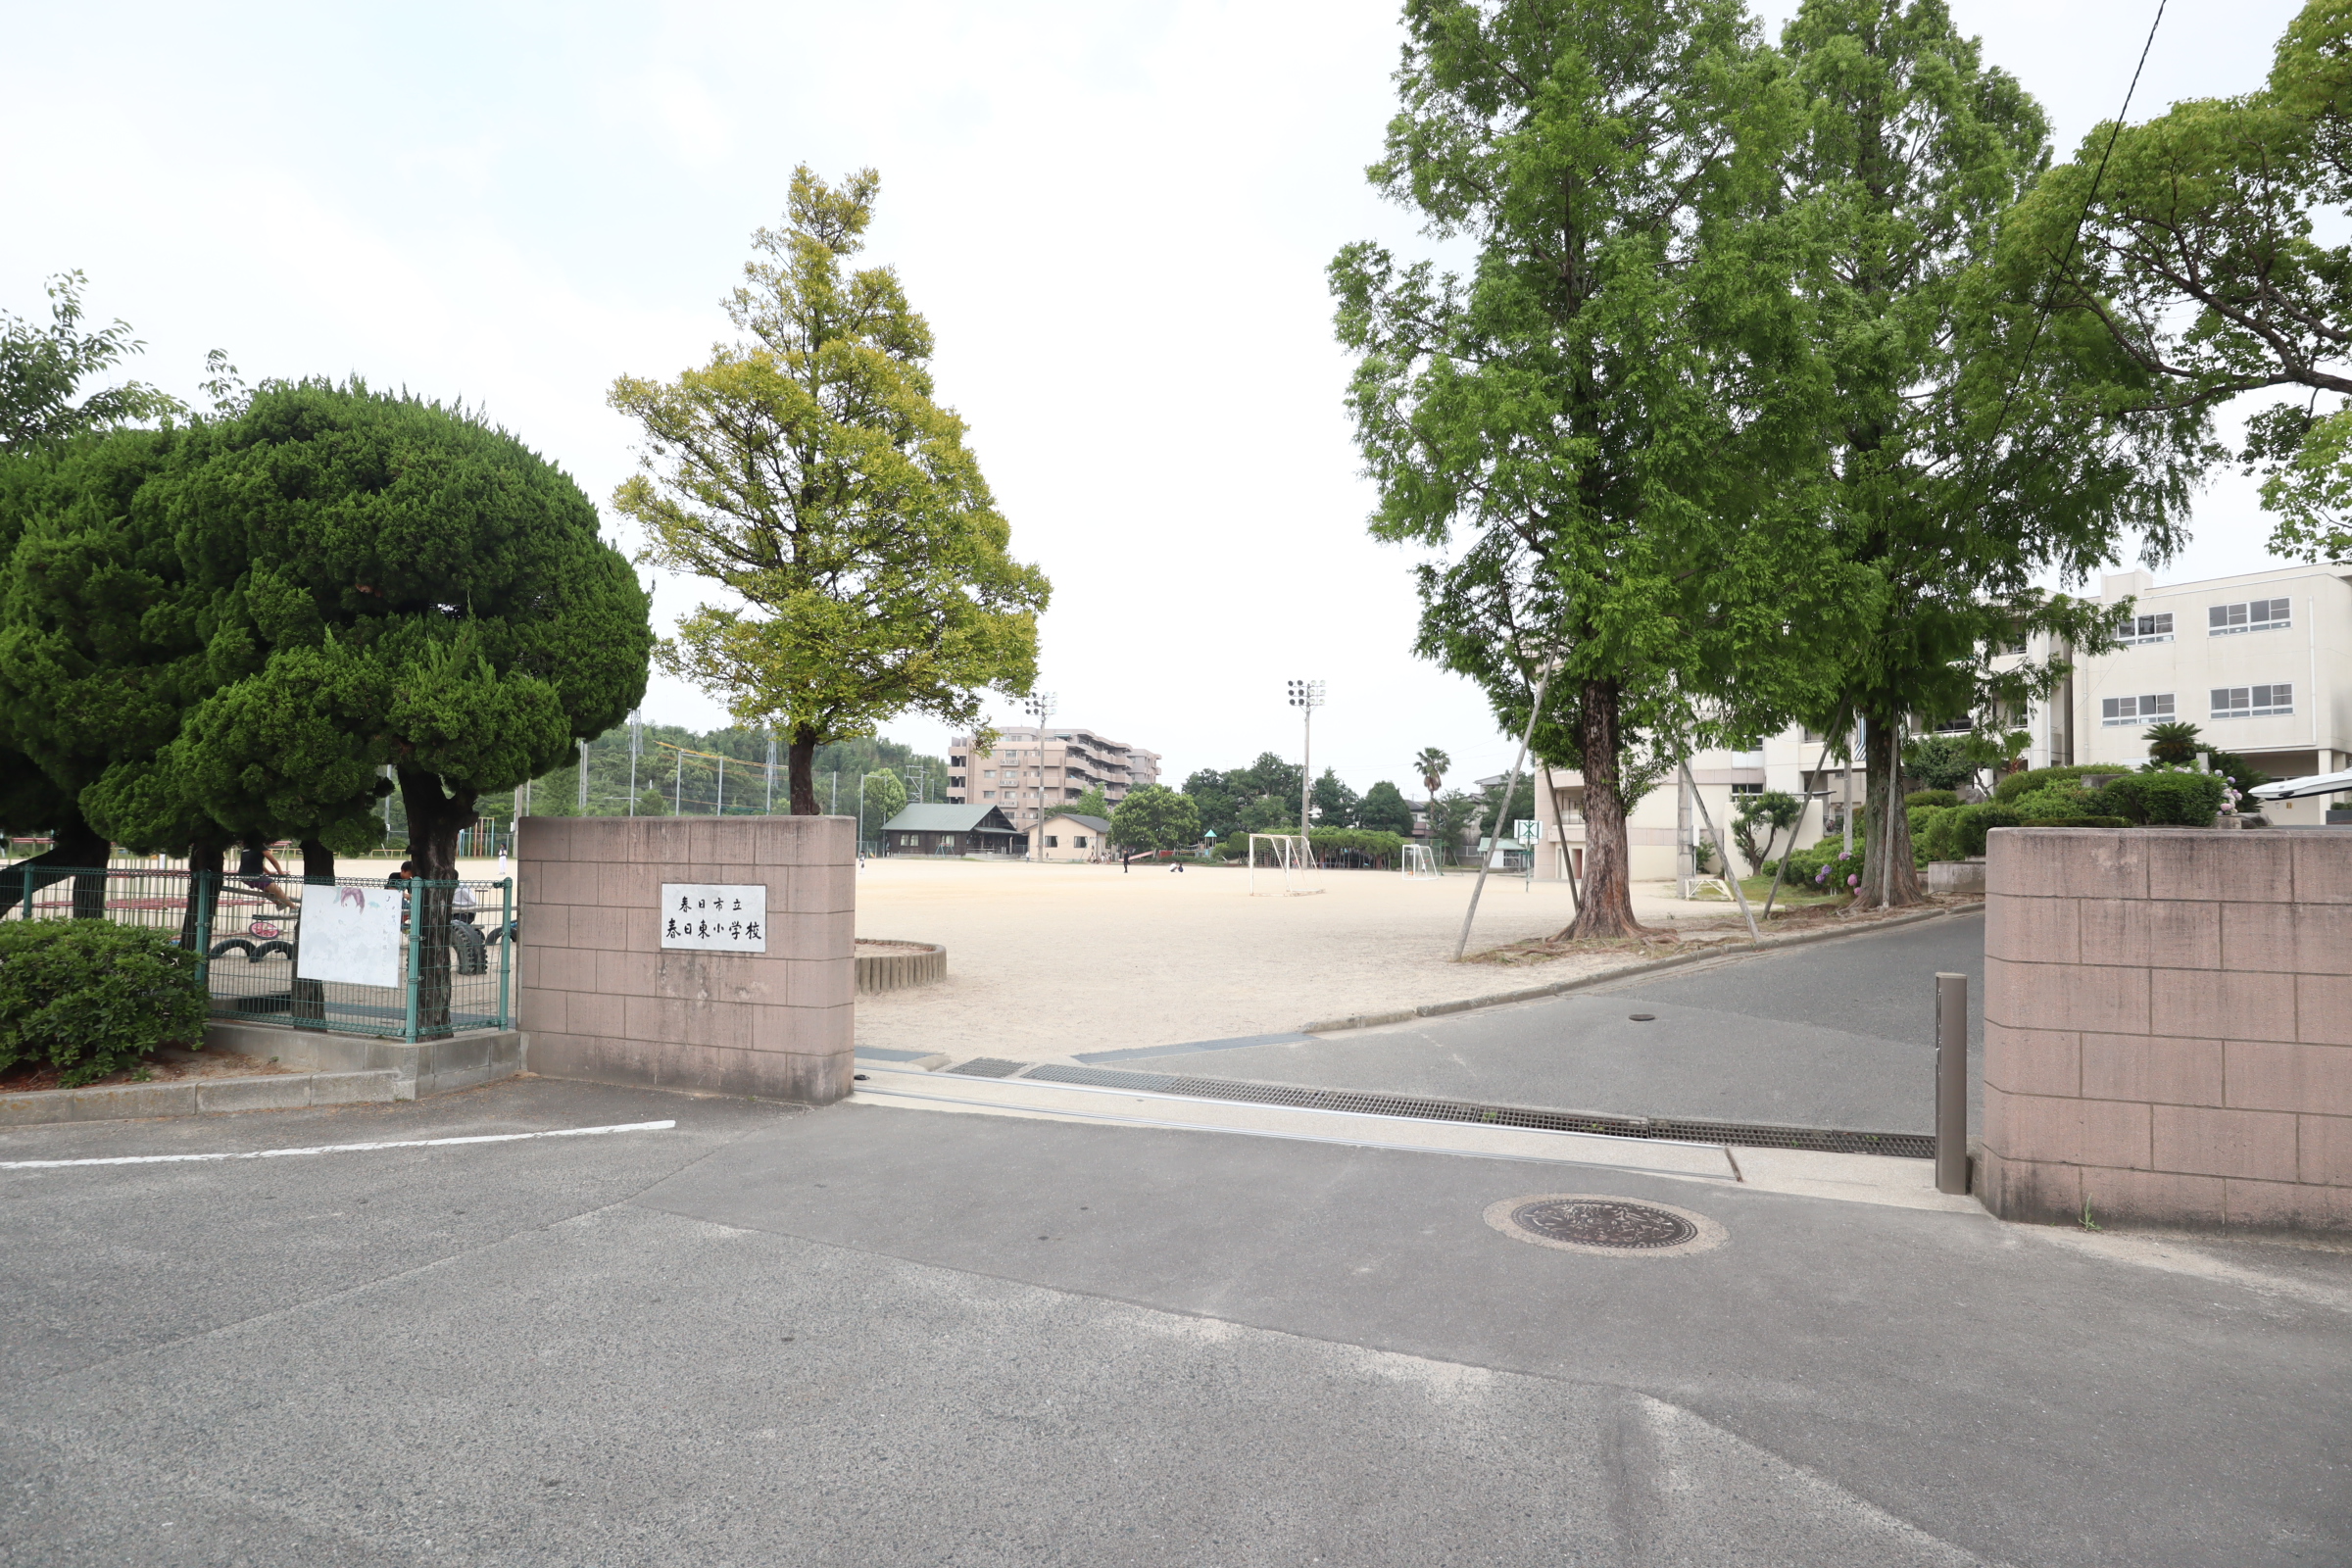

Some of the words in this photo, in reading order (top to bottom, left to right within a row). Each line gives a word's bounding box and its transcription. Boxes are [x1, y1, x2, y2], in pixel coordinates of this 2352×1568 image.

[679, 896, 742, 912] 春日市立
[666, 917, 761, 940] 春日東小学校
